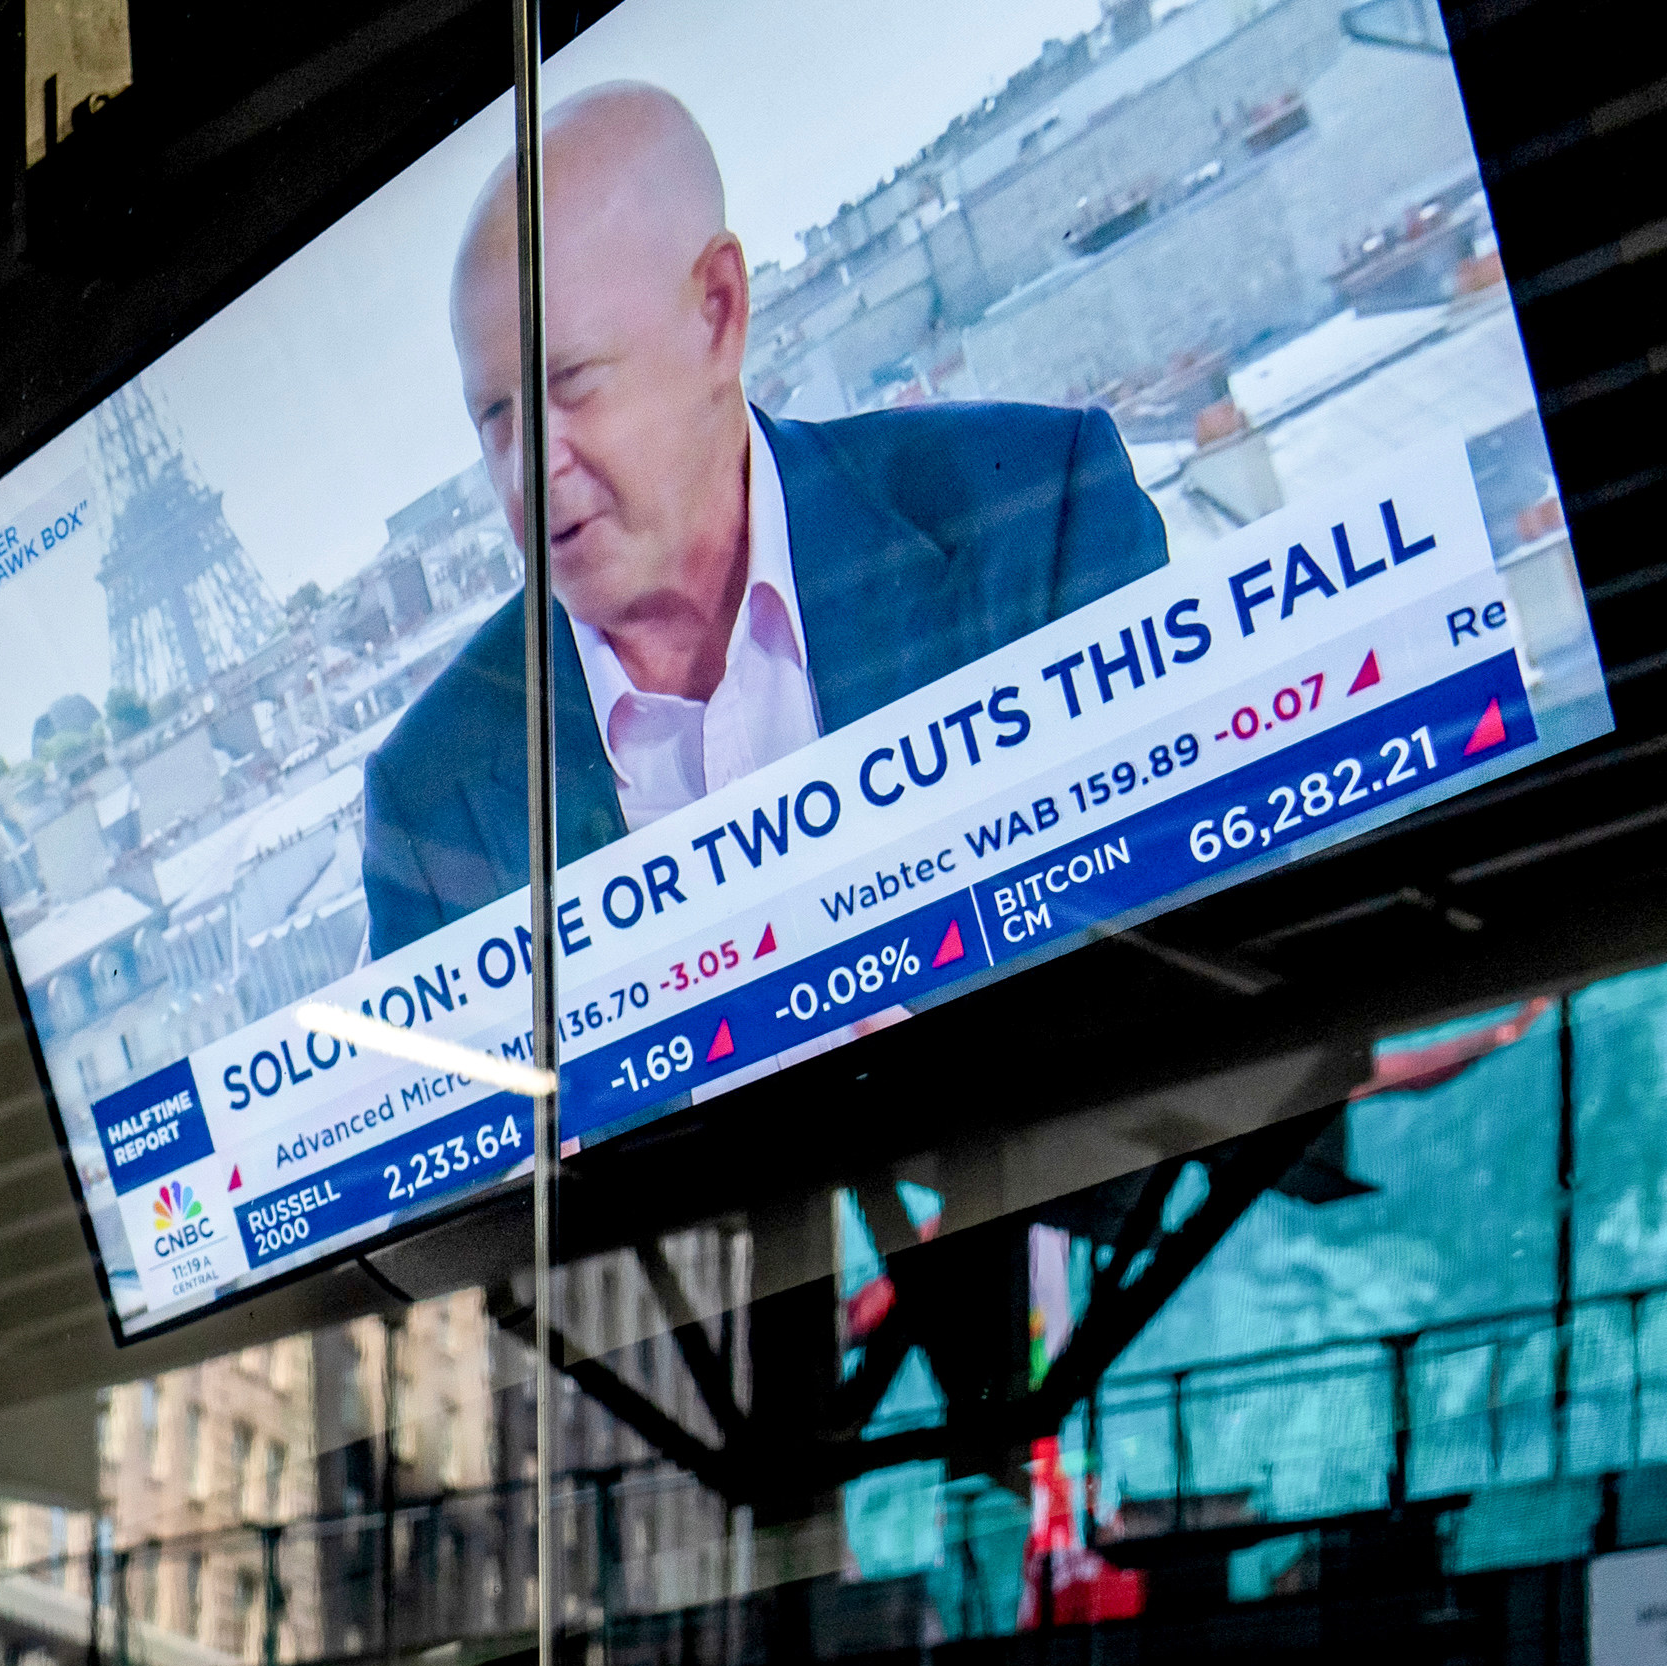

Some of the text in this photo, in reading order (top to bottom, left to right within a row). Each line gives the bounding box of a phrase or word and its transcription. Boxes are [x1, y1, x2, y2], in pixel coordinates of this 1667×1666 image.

[40, 500, 88, 550] BOX"
[601, 854, 688, 931] OR
[691, 780, 841, 887] TWO
[859, 685, 1032, 808] CUTS
[1041, 597, 1213, 720] THIS
[1227, 497, 1436, 638] FALL
[1188, 725, 1440, 865] 66,282.21
[275, 1095, 395, 1169] Advanced
[401, 1073, 472, 1114] Micro
[659, 940, 739, 991] -3.05
[819, 846, 956, 924] Wabtec
[964, 797, 1061, 860] WAB
[1069, 731, 1200, 814] 159.89
[1214, 672, 1326, 744] -0.07
[1446, 598, 1507, 648] Re
[993, 837, 1131, 917] BITCOIN
[1002, 903, 1053, 944] CM
[384, 936, 920, 1199] 2,233.64 -1.69 -0.08%
[107, 1088, 193, 1145] HALFTIME
[114, 1120, 180, 1167] REPORT
[247, 1180, 341, 1233] RUSSELL
[154, 1217, 214, 1257] CNBC
[254, 1218, 310, 1257] 2000
[172, 1269, 220, 1296] CENTRAL
